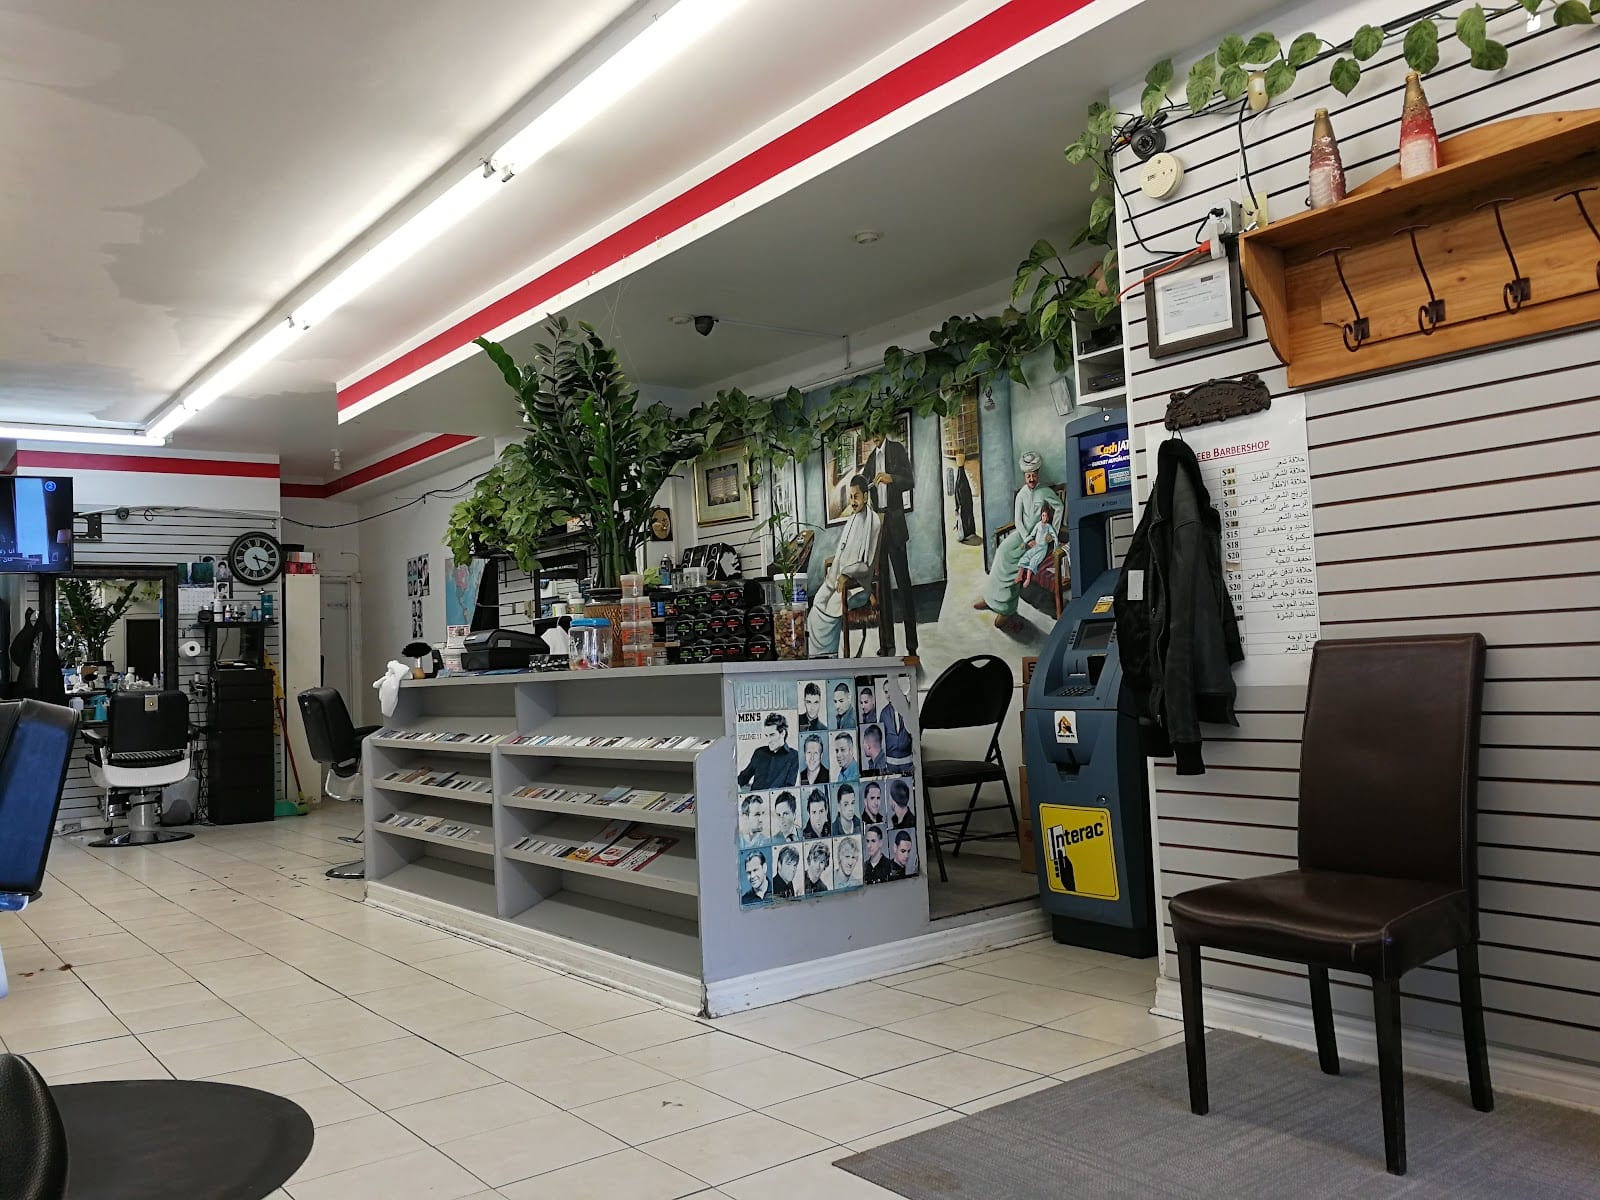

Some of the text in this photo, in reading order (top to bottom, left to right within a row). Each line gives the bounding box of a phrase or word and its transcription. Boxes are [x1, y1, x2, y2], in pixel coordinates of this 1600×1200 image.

[1098, 440, 1130, 455] Cash AT
[1195, 440, 1270, 460] EEB BARBERSHOP
[1225, 510, 1237, 518] $10
[1226, 530, 1238, 538] $15
[738, 712, 761, 723] MEN'S
[1050, 822, 1104, 858] Interac
